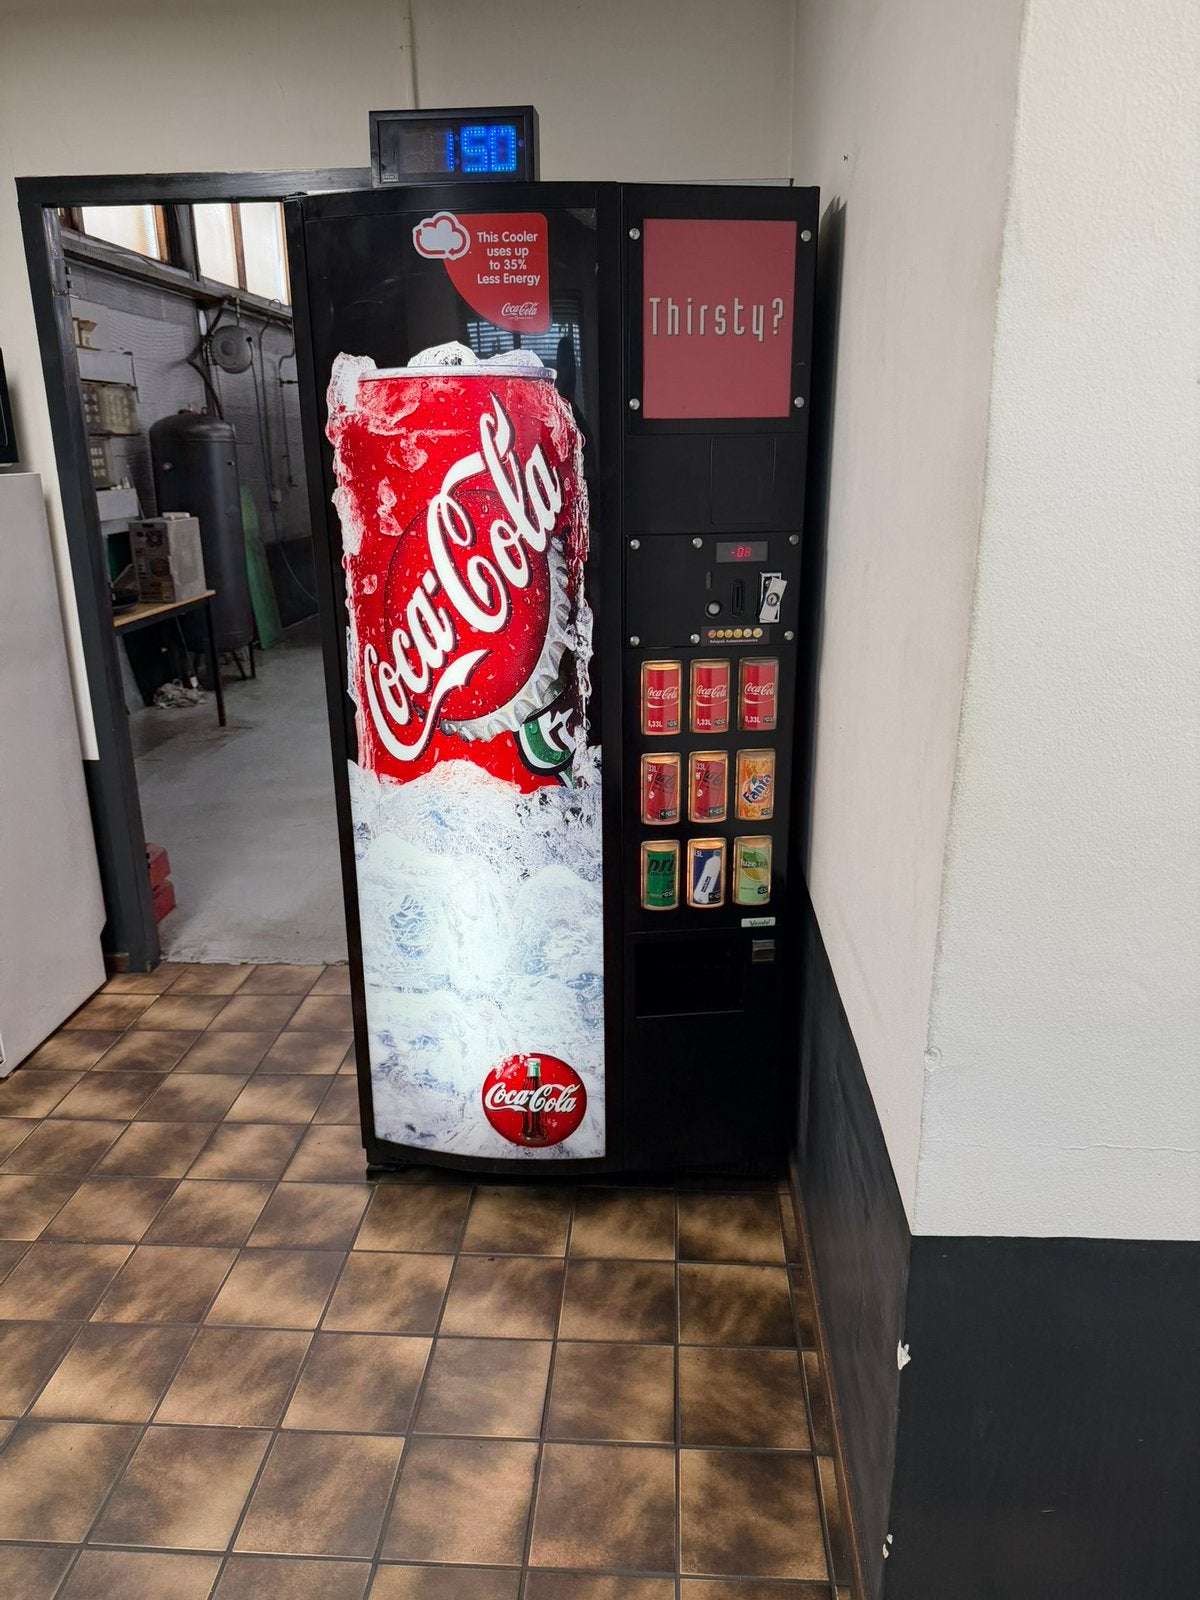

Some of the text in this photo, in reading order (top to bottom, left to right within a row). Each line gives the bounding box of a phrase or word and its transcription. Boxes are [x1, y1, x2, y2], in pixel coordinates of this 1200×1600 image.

[476, 231, 538, 243] This Cooler
[486, 247, 529, 259] uses up
[489, 259, 527, 270] to 35%
[477, 273, 540, 286] Less Energy
[649, 297, 784, 342] Thirsty?
[364, 390, 562, 762] Coca-Cola
[743, 773, 772, 803] Fanta
[484, 1082, 580, 1112] Coca-Cola
